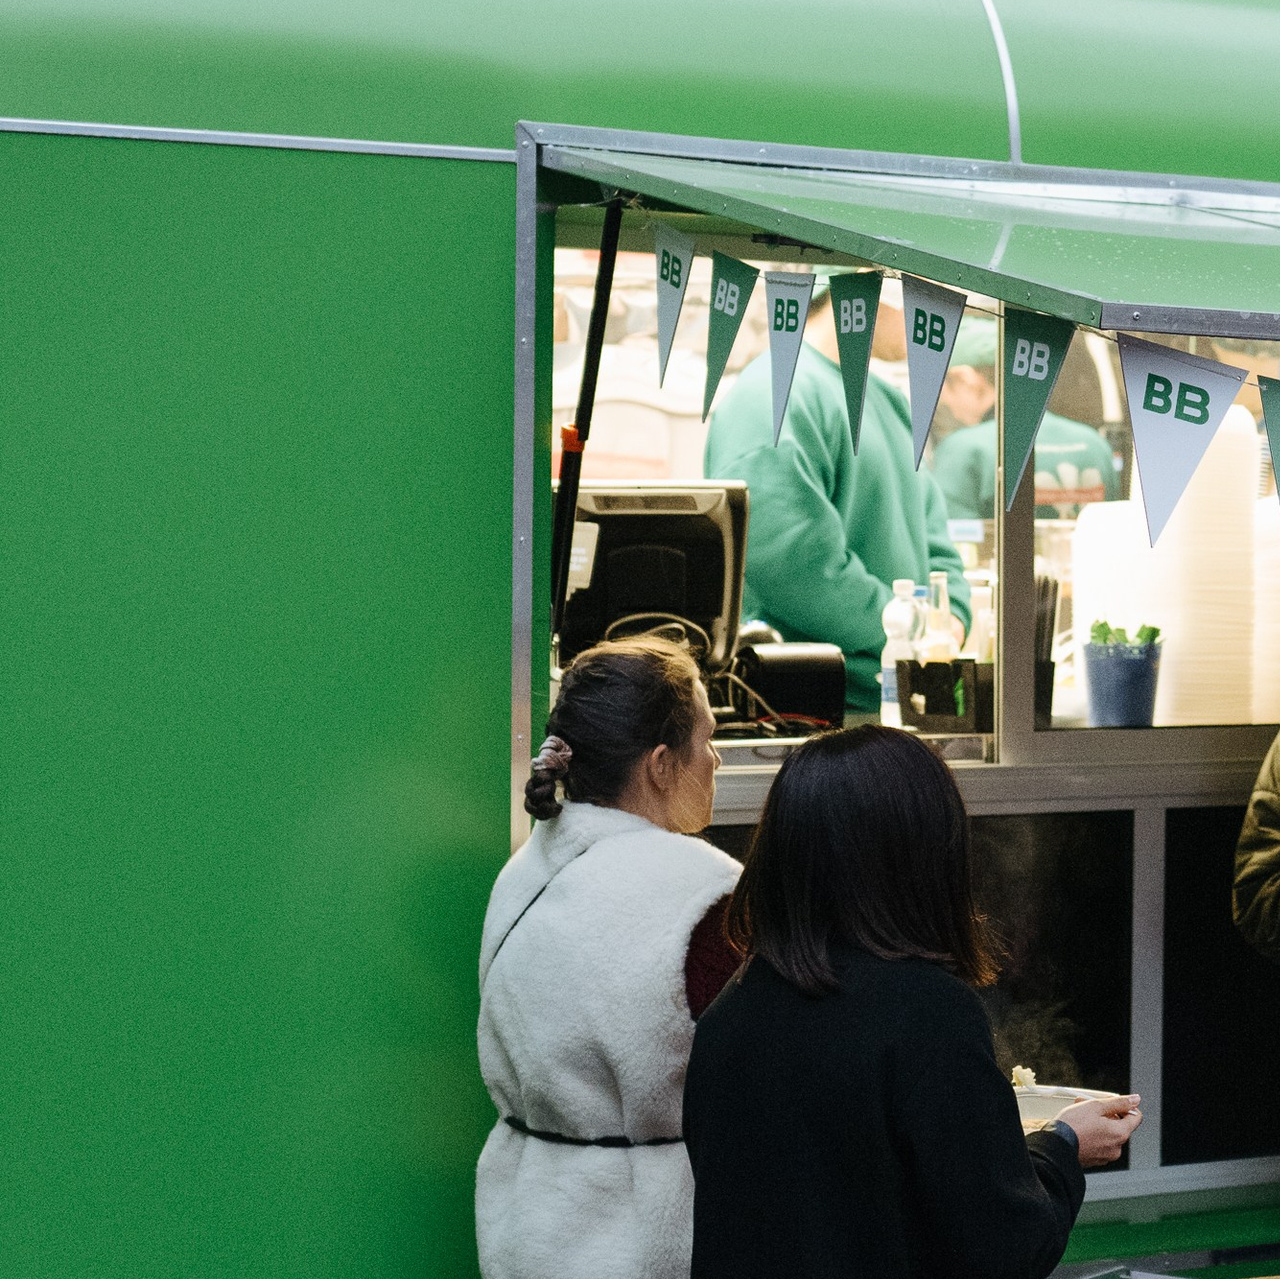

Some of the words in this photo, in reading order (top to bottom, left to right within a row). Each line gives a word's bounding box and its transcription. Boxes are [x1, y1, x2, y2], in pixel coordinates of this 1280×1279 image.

[659, 248, 683, 289] ВВ
[713, 277, 741, 317] ВВ
[773, 297, 799, 333] ВВ
[839, 297, 866, 334] ВВ
[912, 307, 947, 353] ВВ
[1012, 338, 1051, 382] ВВ
[1142, 372, 1211, 425] ВВ
